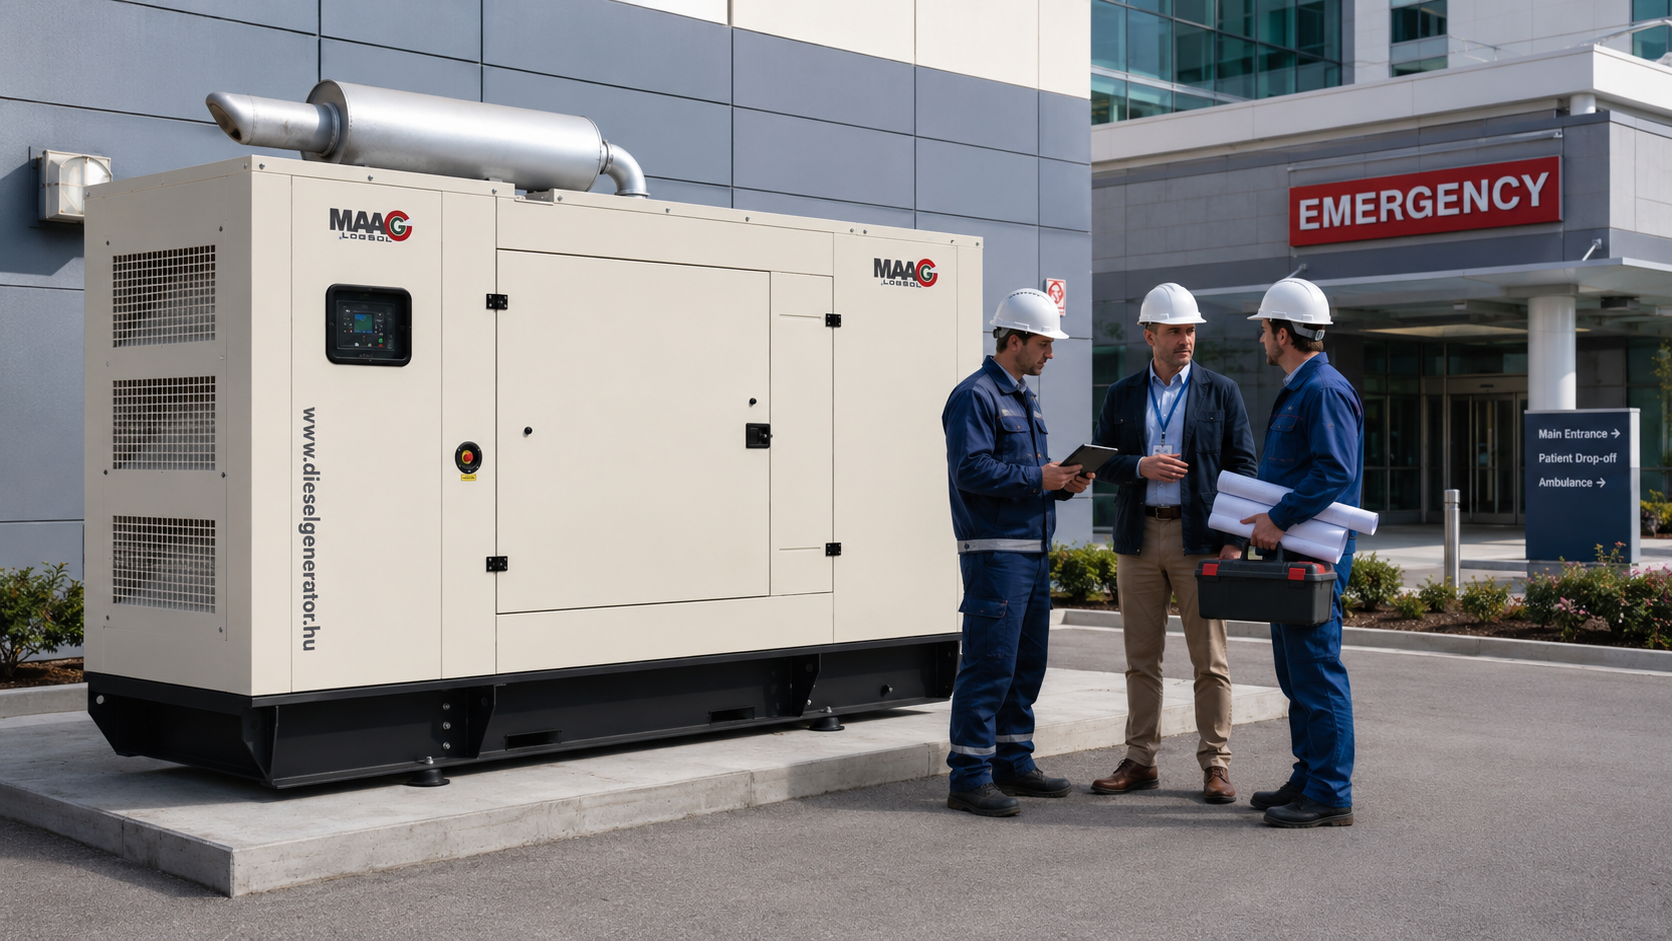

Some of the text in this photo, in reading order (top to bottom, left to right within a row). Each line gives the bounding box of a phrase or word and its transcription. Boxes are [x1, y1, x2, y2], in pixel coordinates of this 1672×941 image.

[1299, 172, 1550, 231] EMERGENCY
[1538, 429, 1608, 439] Main Entrance
[1538, 453, 1618, 465] Patient Drop-off
[1538, 477, 1593, 488] Ambulance
[298, 406, 321, 651] www.dieselgenerator.hu
